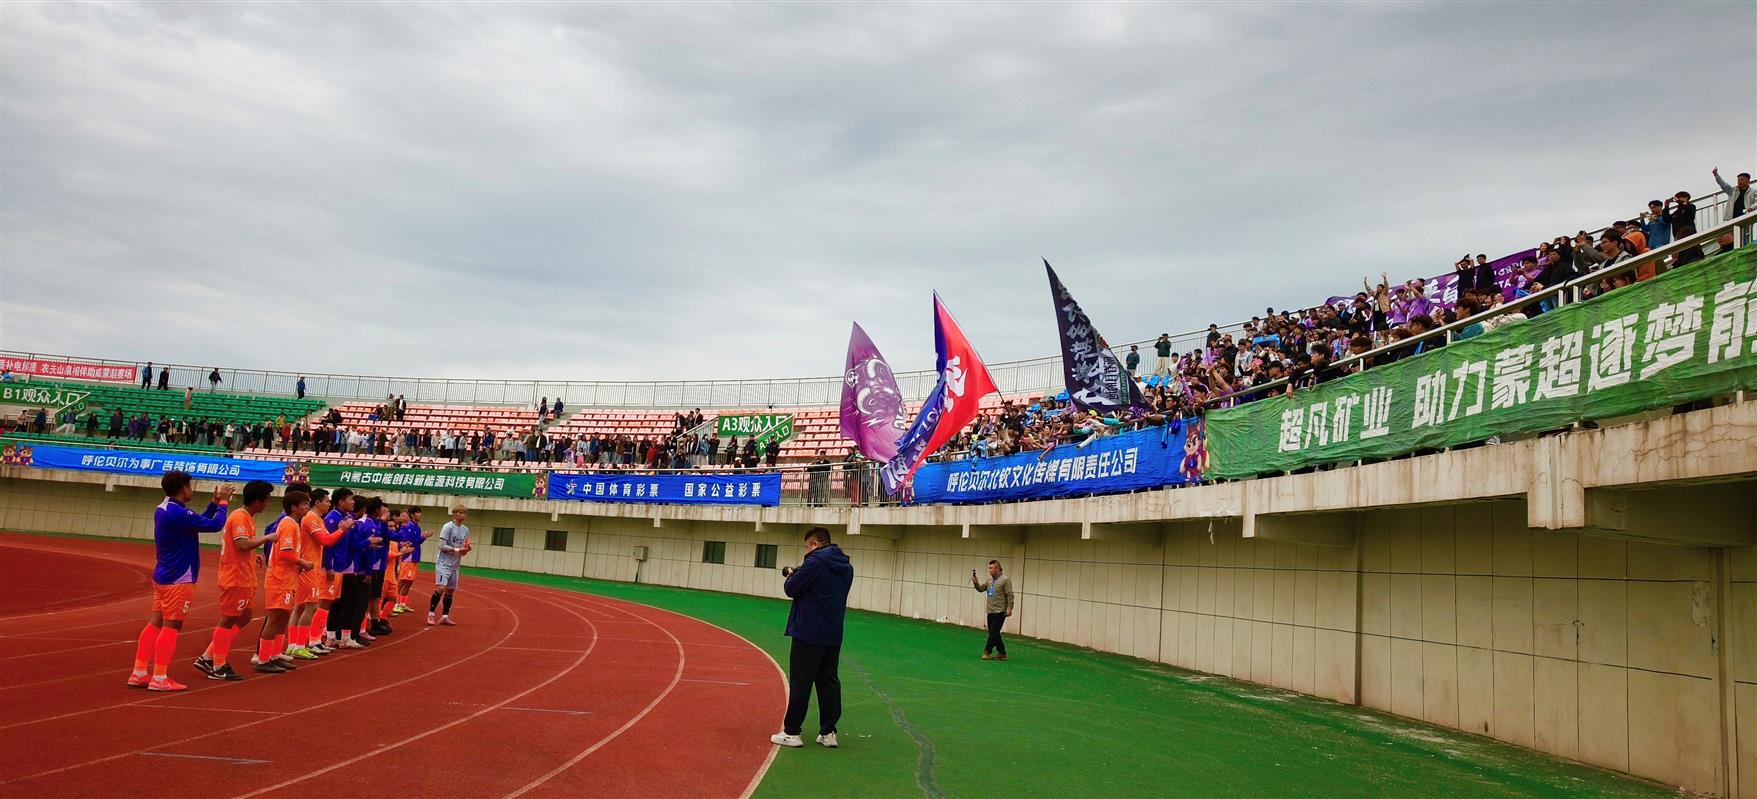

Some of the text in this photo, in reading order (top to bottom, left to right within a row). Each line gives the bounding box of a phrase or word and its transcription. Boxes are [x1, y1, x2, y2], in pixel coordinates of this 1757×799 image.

[3, 387, 80, 406] B1观众入口
[1277, 386, 1393, 453] 超凡矿业
[340, 471, 505, 491] 内蒙古中能创科新能源科技有限公司
[582, 482, 762, 497] 中国体育彩票 国家公益彩票
[182, 600, 190, 613] 5
